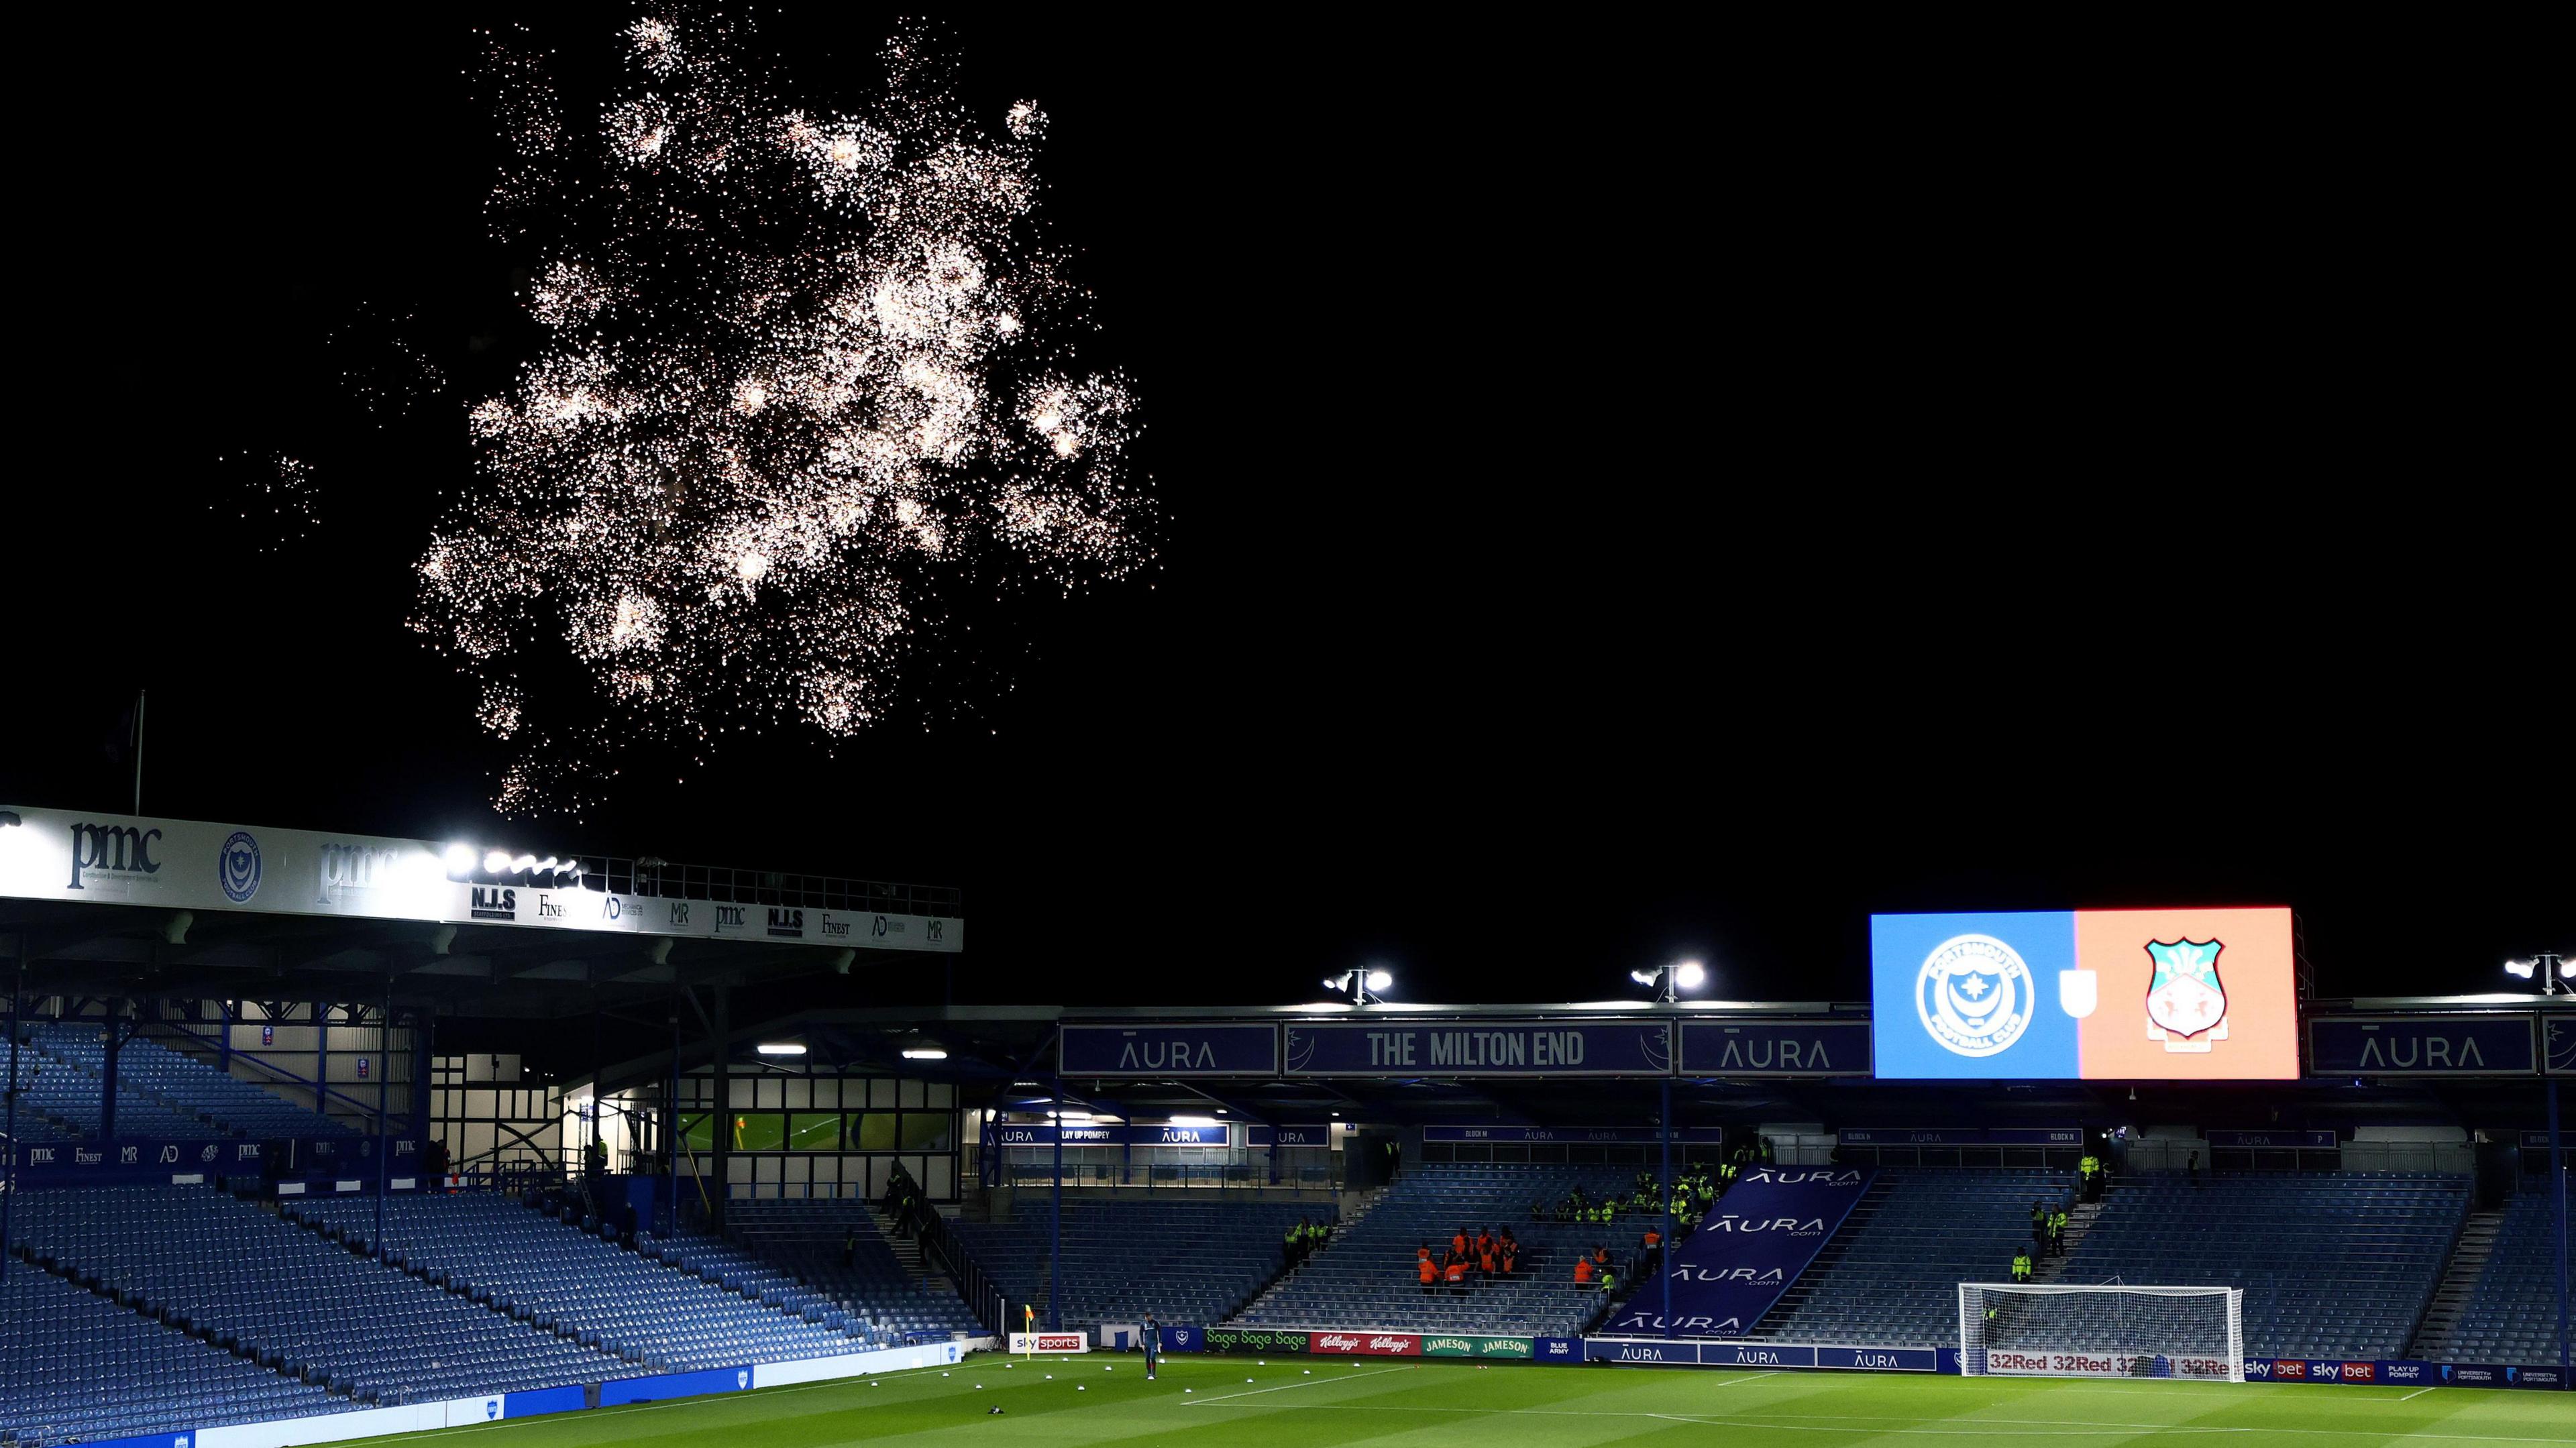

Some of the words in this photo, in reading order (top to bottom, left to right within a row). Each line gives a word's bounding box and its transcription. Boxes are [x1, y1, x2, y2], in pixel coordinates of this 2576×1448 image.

[223, 834, 259, 857] PORTSMOUTH
[67, 822, 162, 889] pmc
[246, 880, 257, 897] CLUB
[472, 887, 516, 910] N.J.S
[669, 903, 688, 923] MR
[714, 905, 745, 932] pmc
[927, 920, 943, 939] MR
[1929, 943, 2022, 979] PORTSMOUTH
[1931, 1014, 1993, 1048] FOOTBALL
[1993, 1013, 2021, 1043] CLUB
[1366, 1032, 1416, 1065] THE
[1430, 1032, 1525, 1065] MILTON
[1534, 1032, 1584, 1065] END
[1062, 1131, 1074, 1139] LAY
[1075, 1131, 1084, 1139] UP
[1084, 1131, 1110, 1139] POMPEY
[1278, 1132, 1305, 1144] URA
[1847, 1133, 1866, 1141] BLOCK
[2050, 1133, 2068, 1141] BLOCK
[2069, 1133, 2074, 1141] N
[2318, 1135, 2323, 1144] P
[120, 1146, 138, 1162] MR
[238, 1144, 261, 1162] pmc
[395, 1140, 416, 1156] pmc
[30, 1148, 55, 1166] pmc
[1040, 1337, 1078, 1349] sports
[1208, 1329, 1237, 1349] Sage
[1242, 1330, 1272, 1349] Sage
[1276, 1331, 1306, 1351] Sage
[1320, 1335, 1359, 1351] Kellogg's
[1370, 1336, 1410, 1352] Kellogg's
[1427, 1339, 1471, 1352] JAMESON
[1483, 1340, 1527, 1353] JAMESON
[1990, 1354, 2047, 1370] 32Red
[2053, 1355, 2112, 1372] 32Red
[2245, 1361, 2271, 1377] sky
[2277, 1361, 2302, 1375] bet
[2313, 1363, 2339, 1379] sky
[2345, 1364, 2371, 1378] bet
